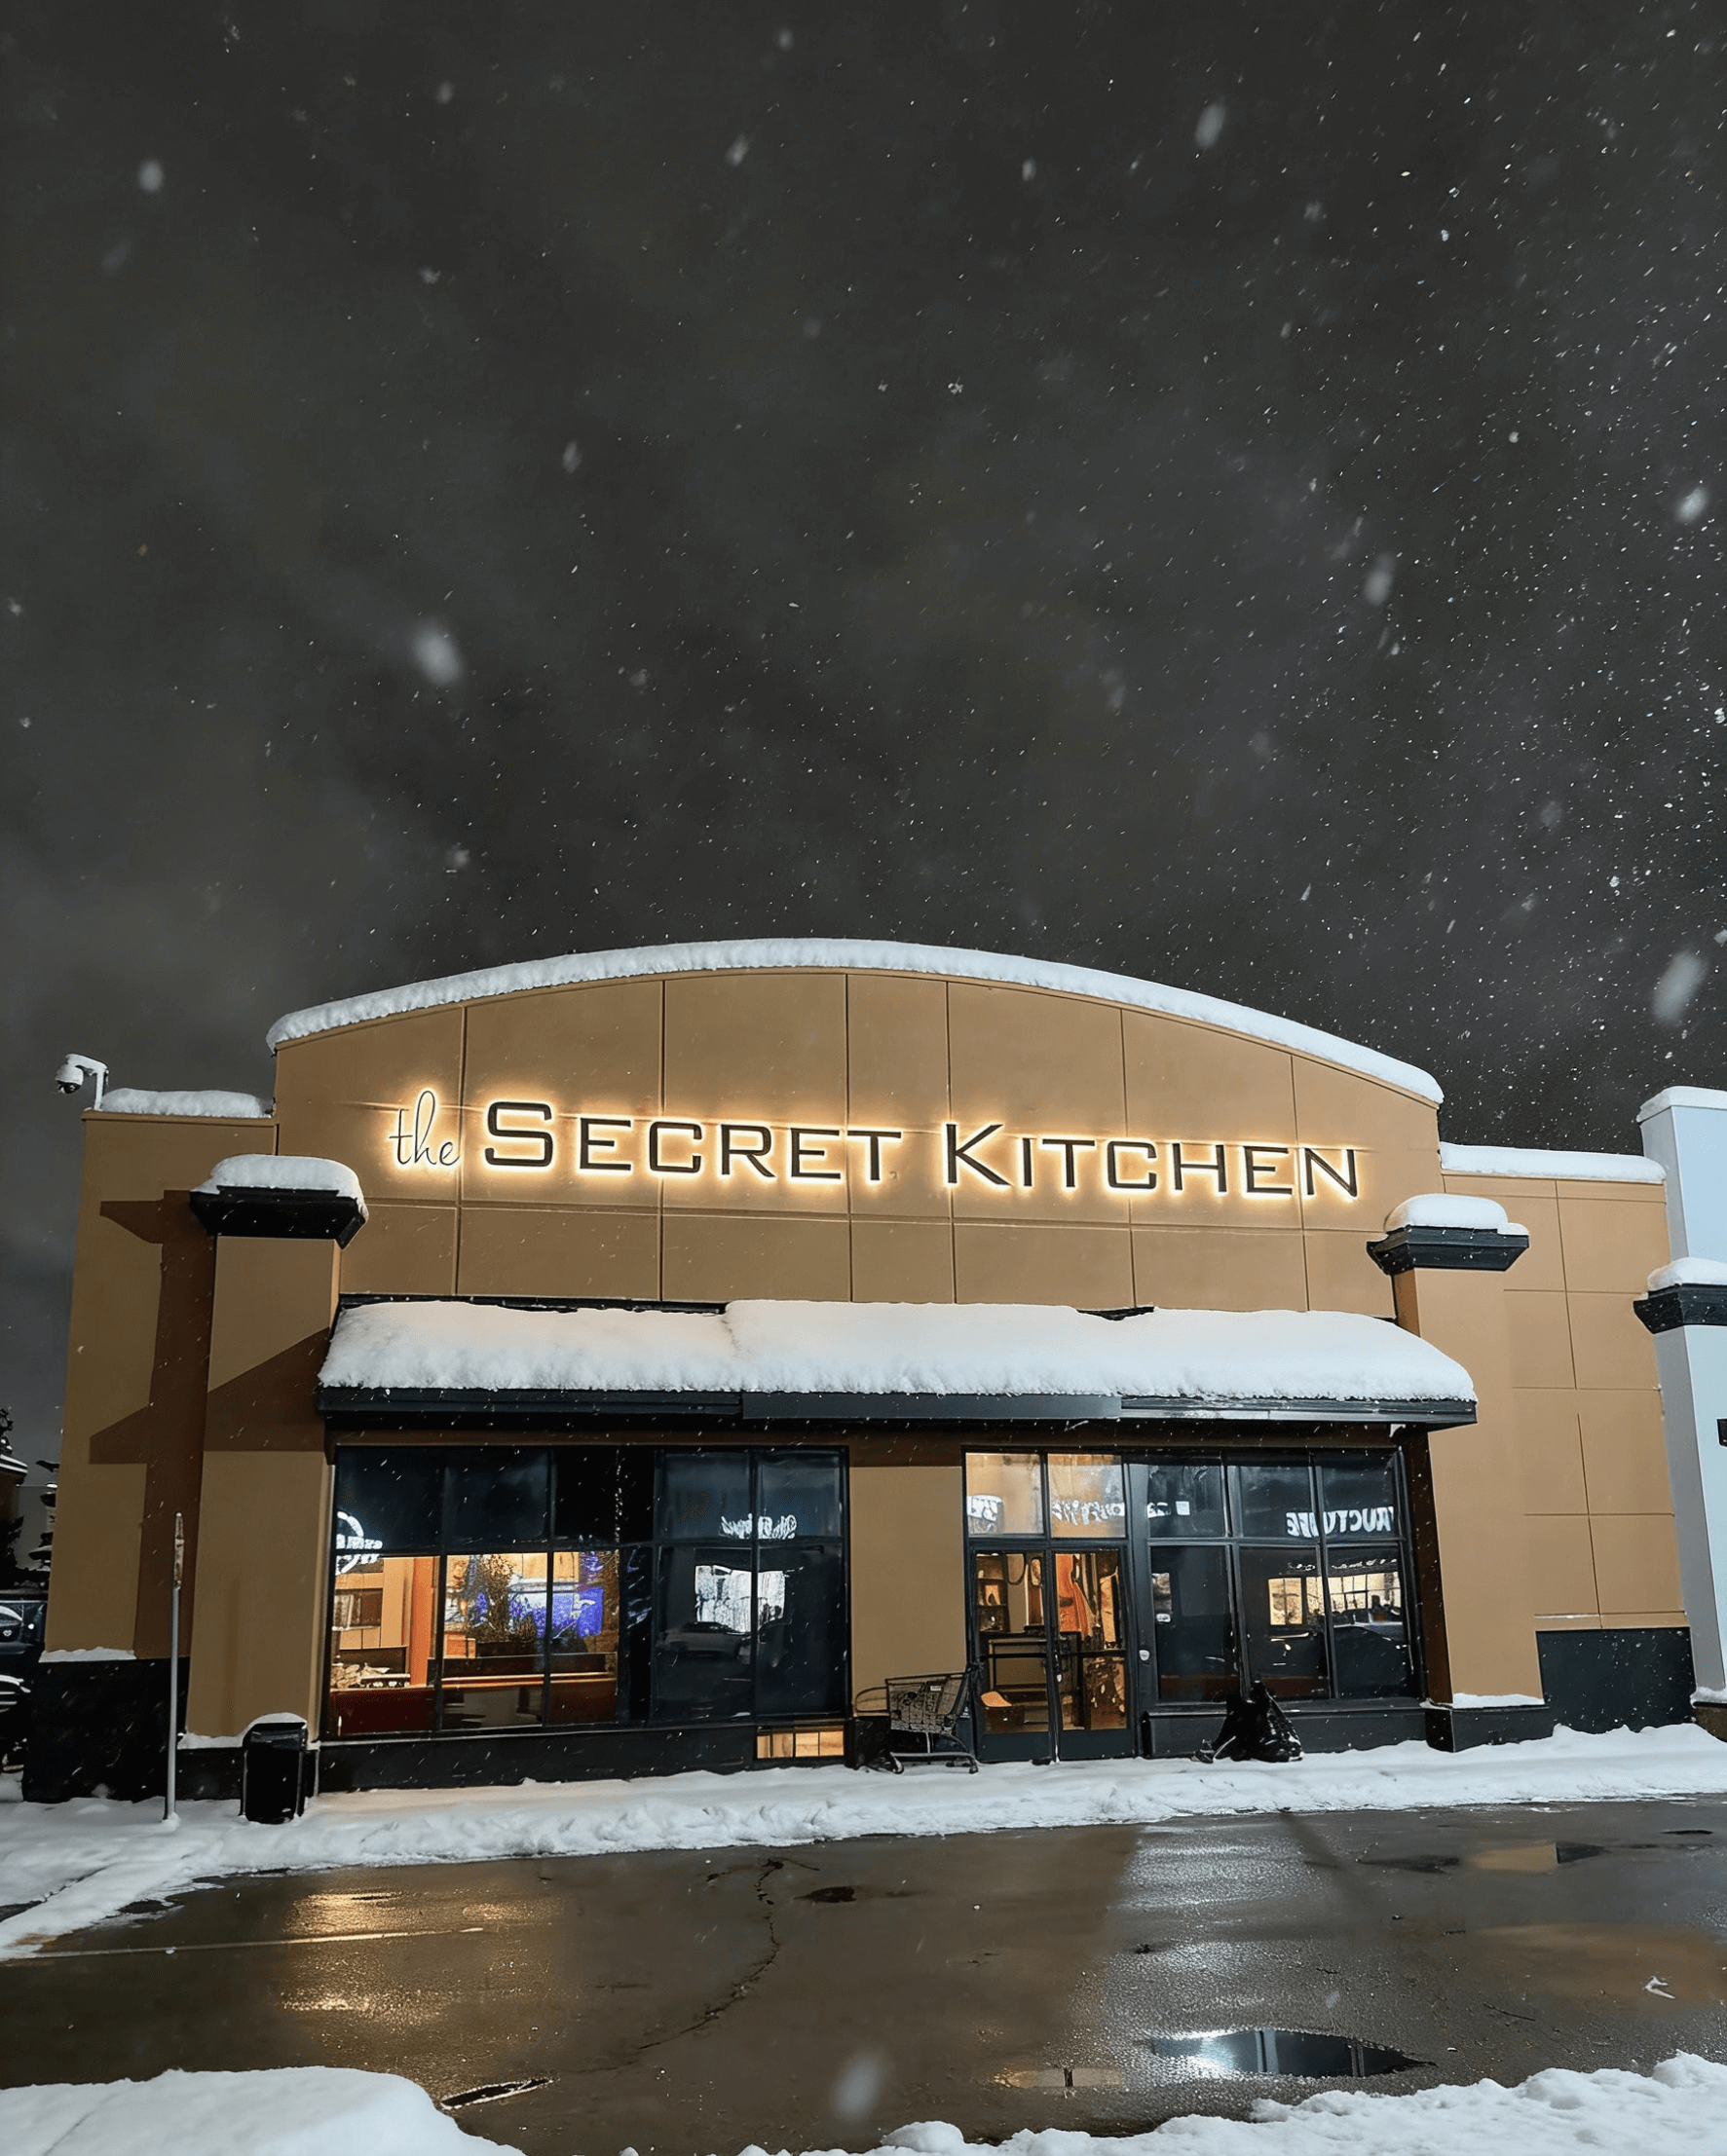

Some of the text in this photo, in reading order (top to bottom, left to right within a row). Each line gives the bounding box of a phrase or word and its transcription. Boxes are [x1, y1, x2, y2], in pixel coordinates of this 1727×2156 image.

[389, 1090, 1359, 1199] the SECRET KITCHEN
